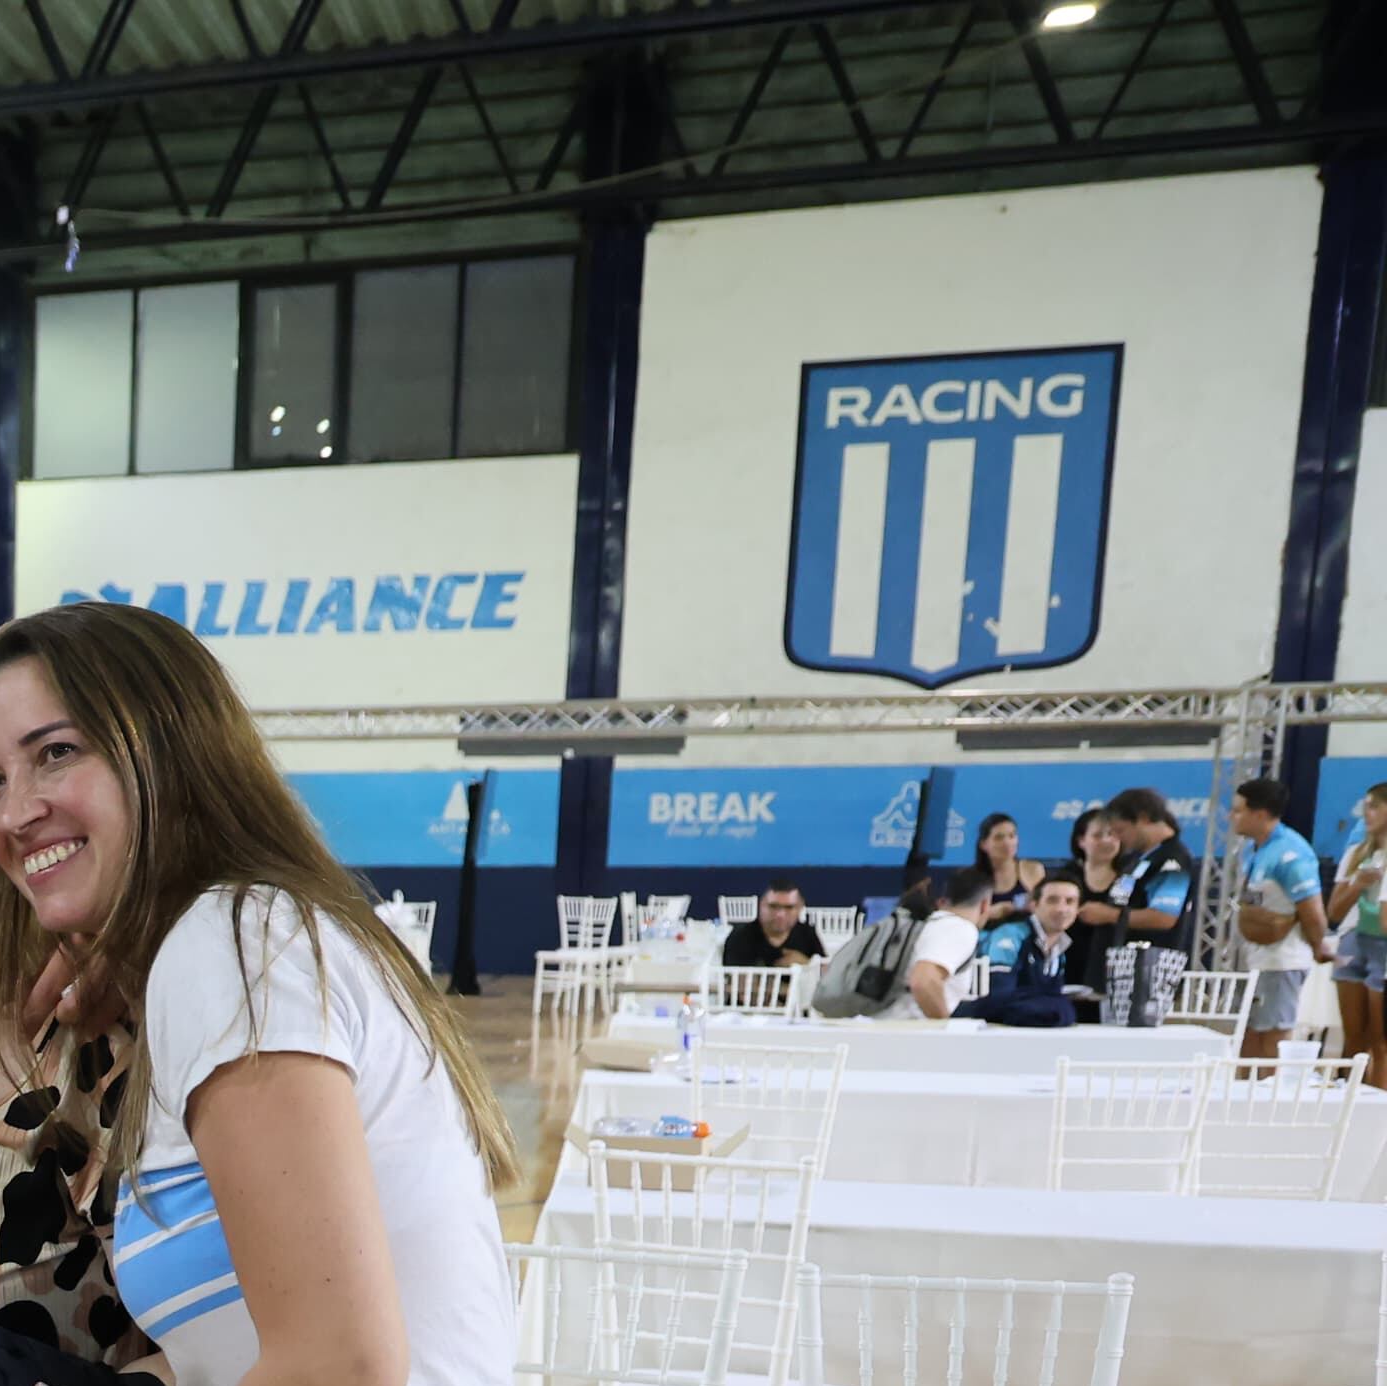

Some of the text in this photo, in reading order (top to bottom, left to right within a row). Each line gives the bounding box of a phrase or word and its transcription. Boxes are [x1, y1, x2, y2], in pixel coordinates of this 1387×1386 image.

[824, 374, 1086, 428] RACING
[144, 570, 526, 638] ALLIANCE
[648, 793, 775, 823] BREAK
